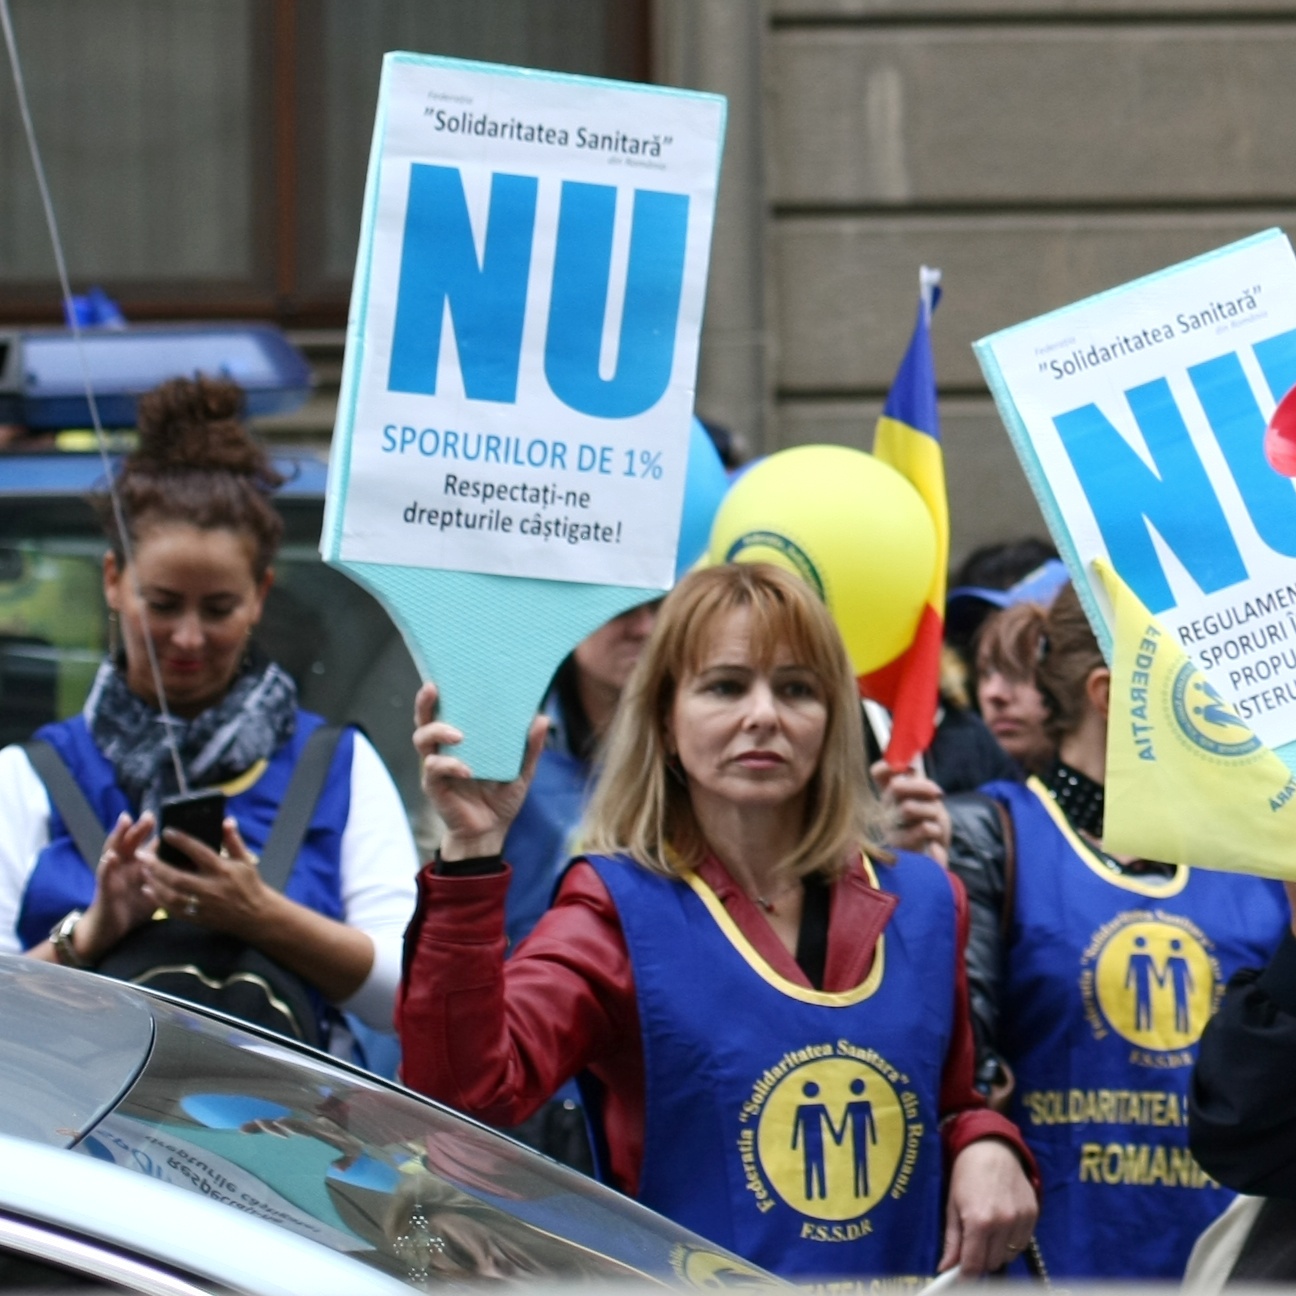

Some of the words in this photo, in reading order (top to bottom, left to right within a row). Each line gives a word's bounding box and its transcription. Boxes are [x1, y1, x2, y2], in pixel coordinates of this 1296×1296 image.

[386, 162, 692, 420] NU
[381, 423, 568, 471] SPORURILOR
[576, 444, 614, 475] DE
[623, 449, 664, 480] 1%
[443, 473, 591, 510] Respectați-ne
[403, 501, 515, 534] drepturile
[1199, 620, 1289, 671] SPORURI
